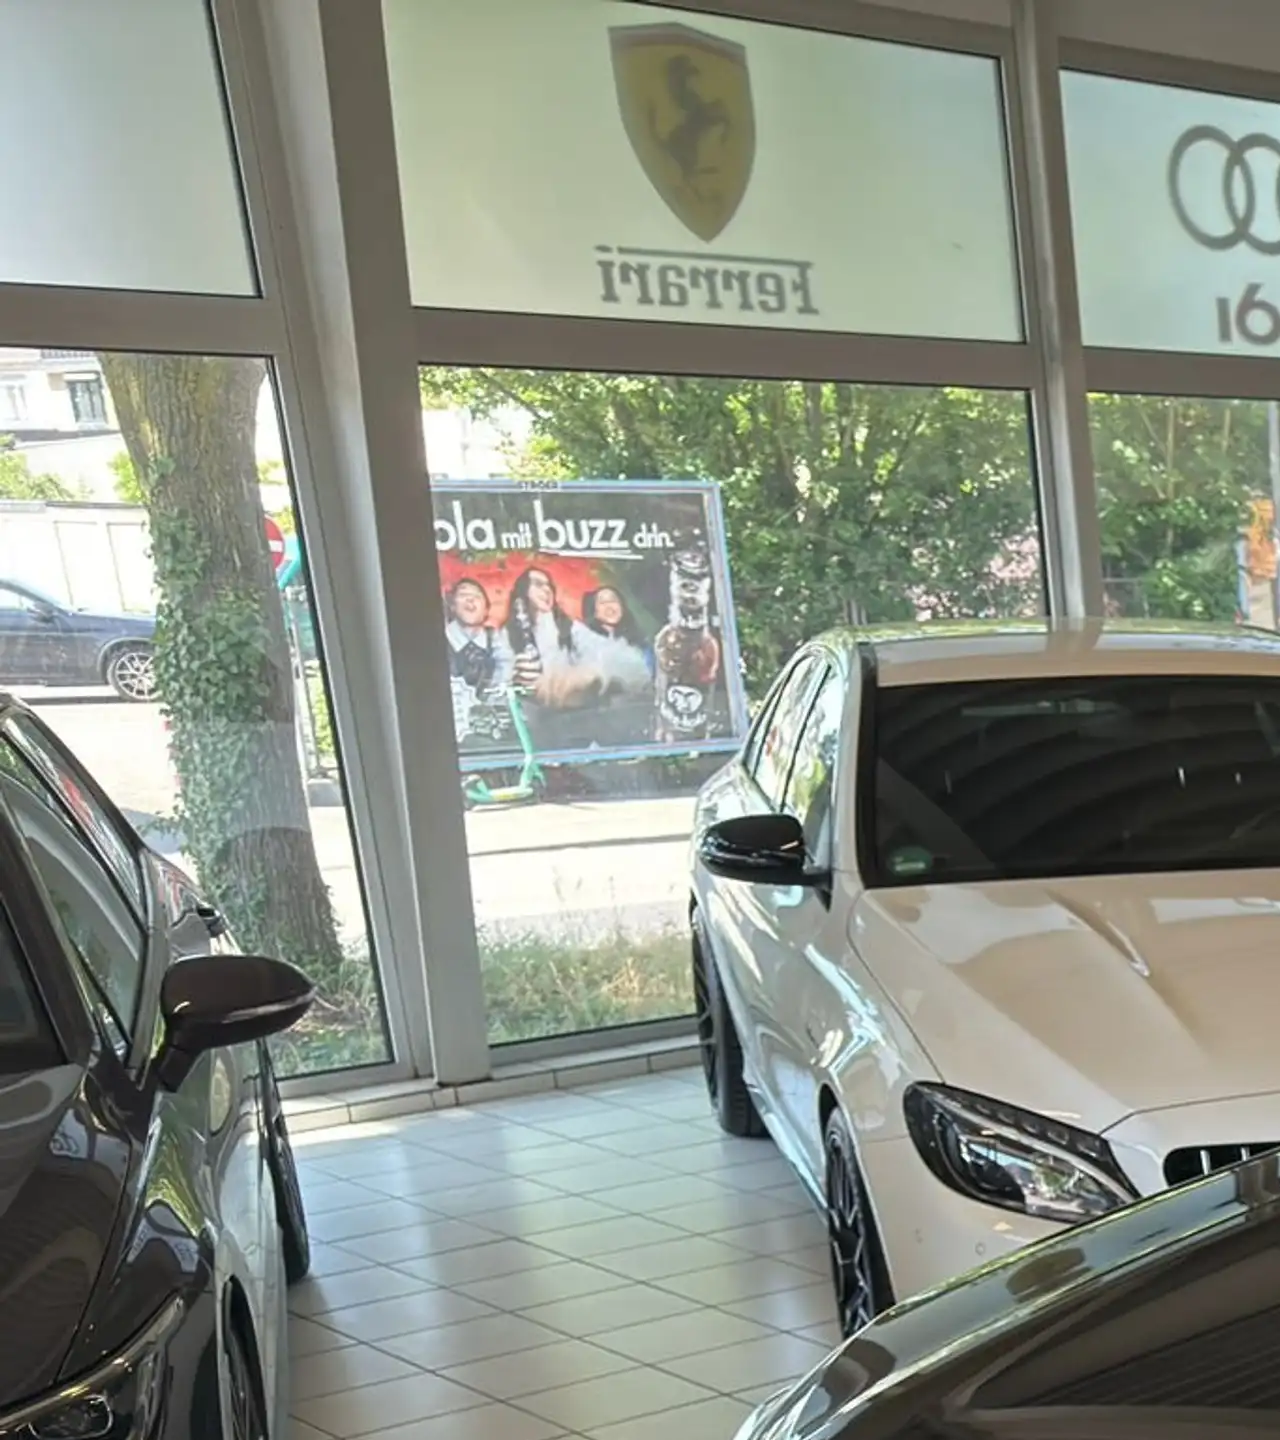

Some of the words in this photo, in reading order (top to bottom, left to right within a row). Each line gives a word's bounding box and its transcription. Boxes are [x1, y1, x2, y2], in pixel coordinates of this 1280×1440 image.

[433, 500, 496, 551] ola
[501, 521, 533, 550] mit
[534, 499, 629, 549] buzz
